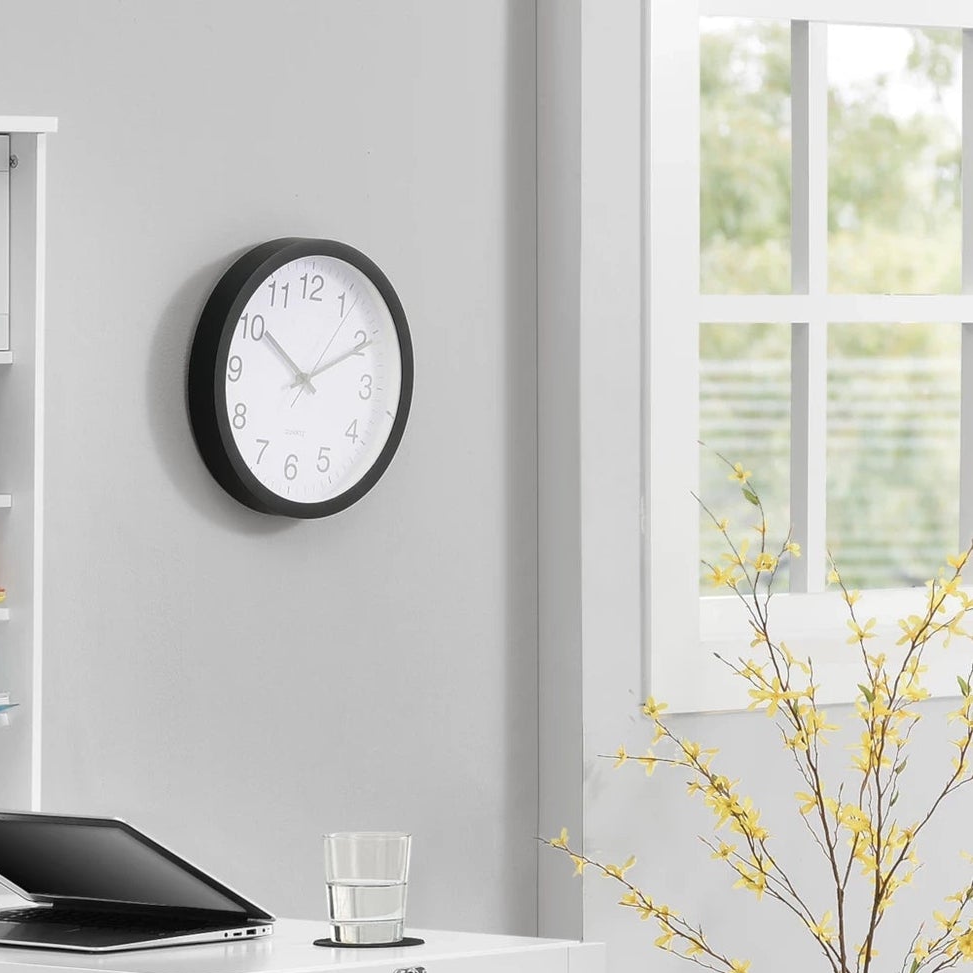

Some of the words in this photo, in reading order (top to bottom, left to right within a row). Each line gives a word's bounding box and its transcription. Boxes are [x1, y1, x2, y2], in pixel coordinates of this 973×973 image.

[268, 280, 290, 308] 11
[300, 273, 324, 301] 12
[337, 291, 346, 318] 1
[240, 312, 265, 341] 10
[352, 330, 367, 357] 2
[228, 355, 243, 382] 9
[359, 374, 373, 400] 3
[232, 403, 247, 429] 8
[345, 419, 359, 444] 4
[255, 439, 269, 464] 7
[316, 447, 331, 473] 5
[283, 454, 298, 480] 6
